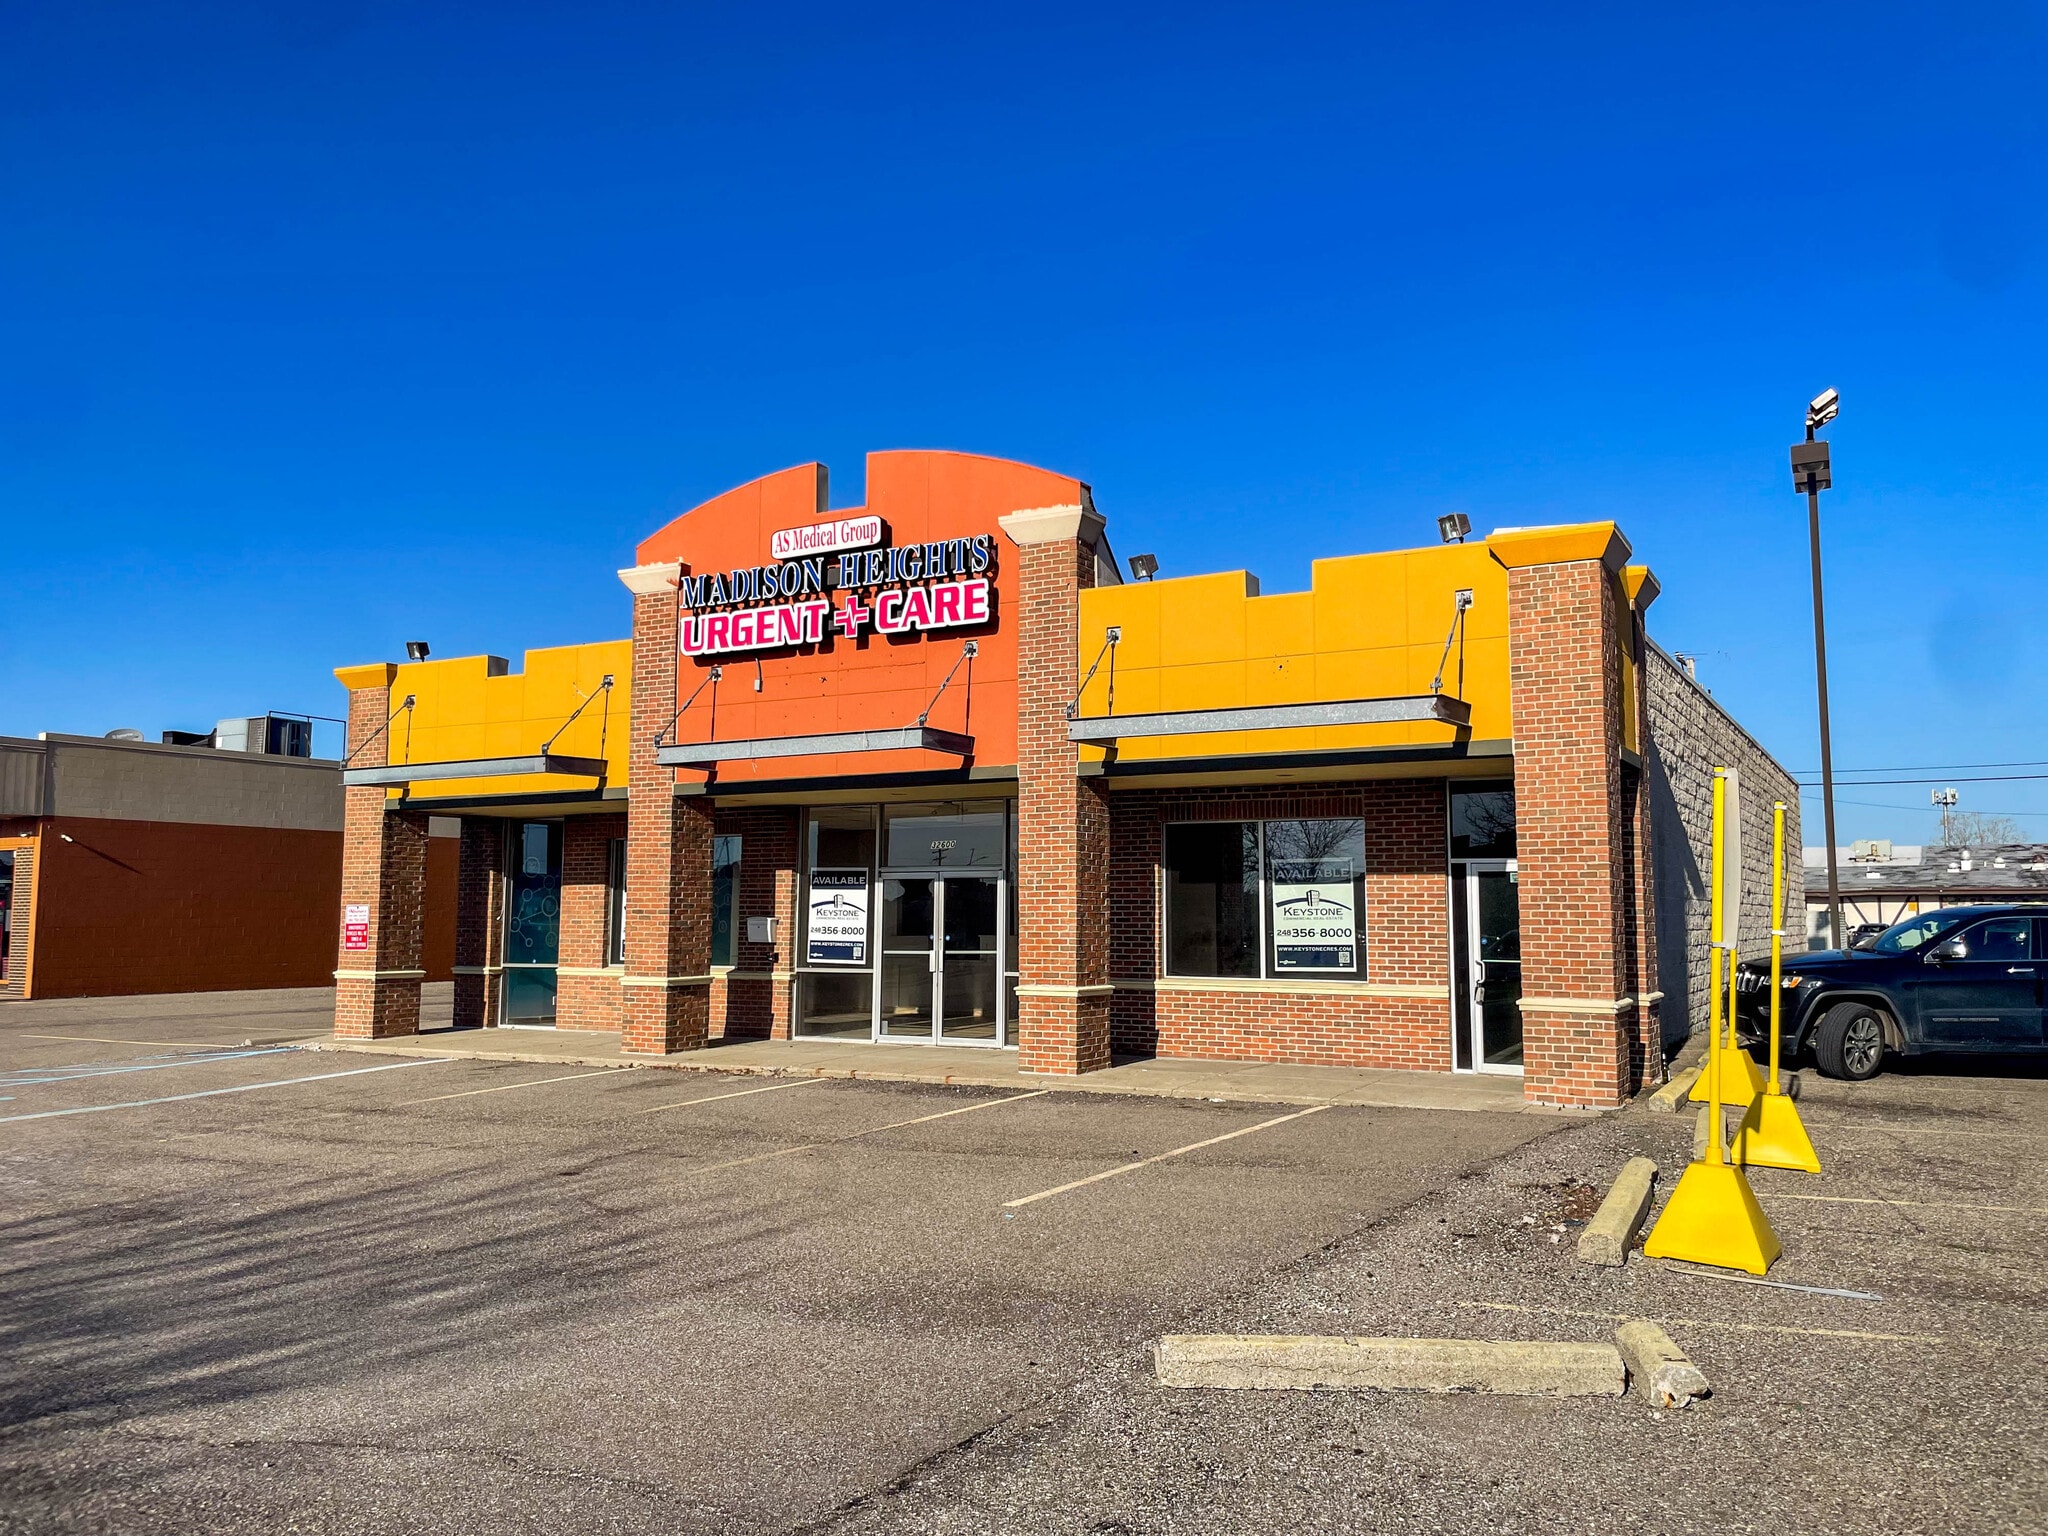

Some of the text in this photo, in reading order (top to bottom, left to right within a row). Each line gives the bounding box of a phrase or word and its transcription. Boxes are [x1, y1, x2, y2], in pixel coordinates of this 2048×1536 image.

[775, 520, 878, 553] AS Medical Group
[680, 534, 990, 609] MADISON HEIGHTS
[680, 578, 990, 656] URGENT CARE
[931, 840, 956, 849] 32600
[1275, 868, 1350, 879] AVAILABLE
[812, 876, 866, 885] AVAILABLE
[816, 908, 860, 917] KEYSTONE
[1283, 907, 1344, 916] KEYSTONE
